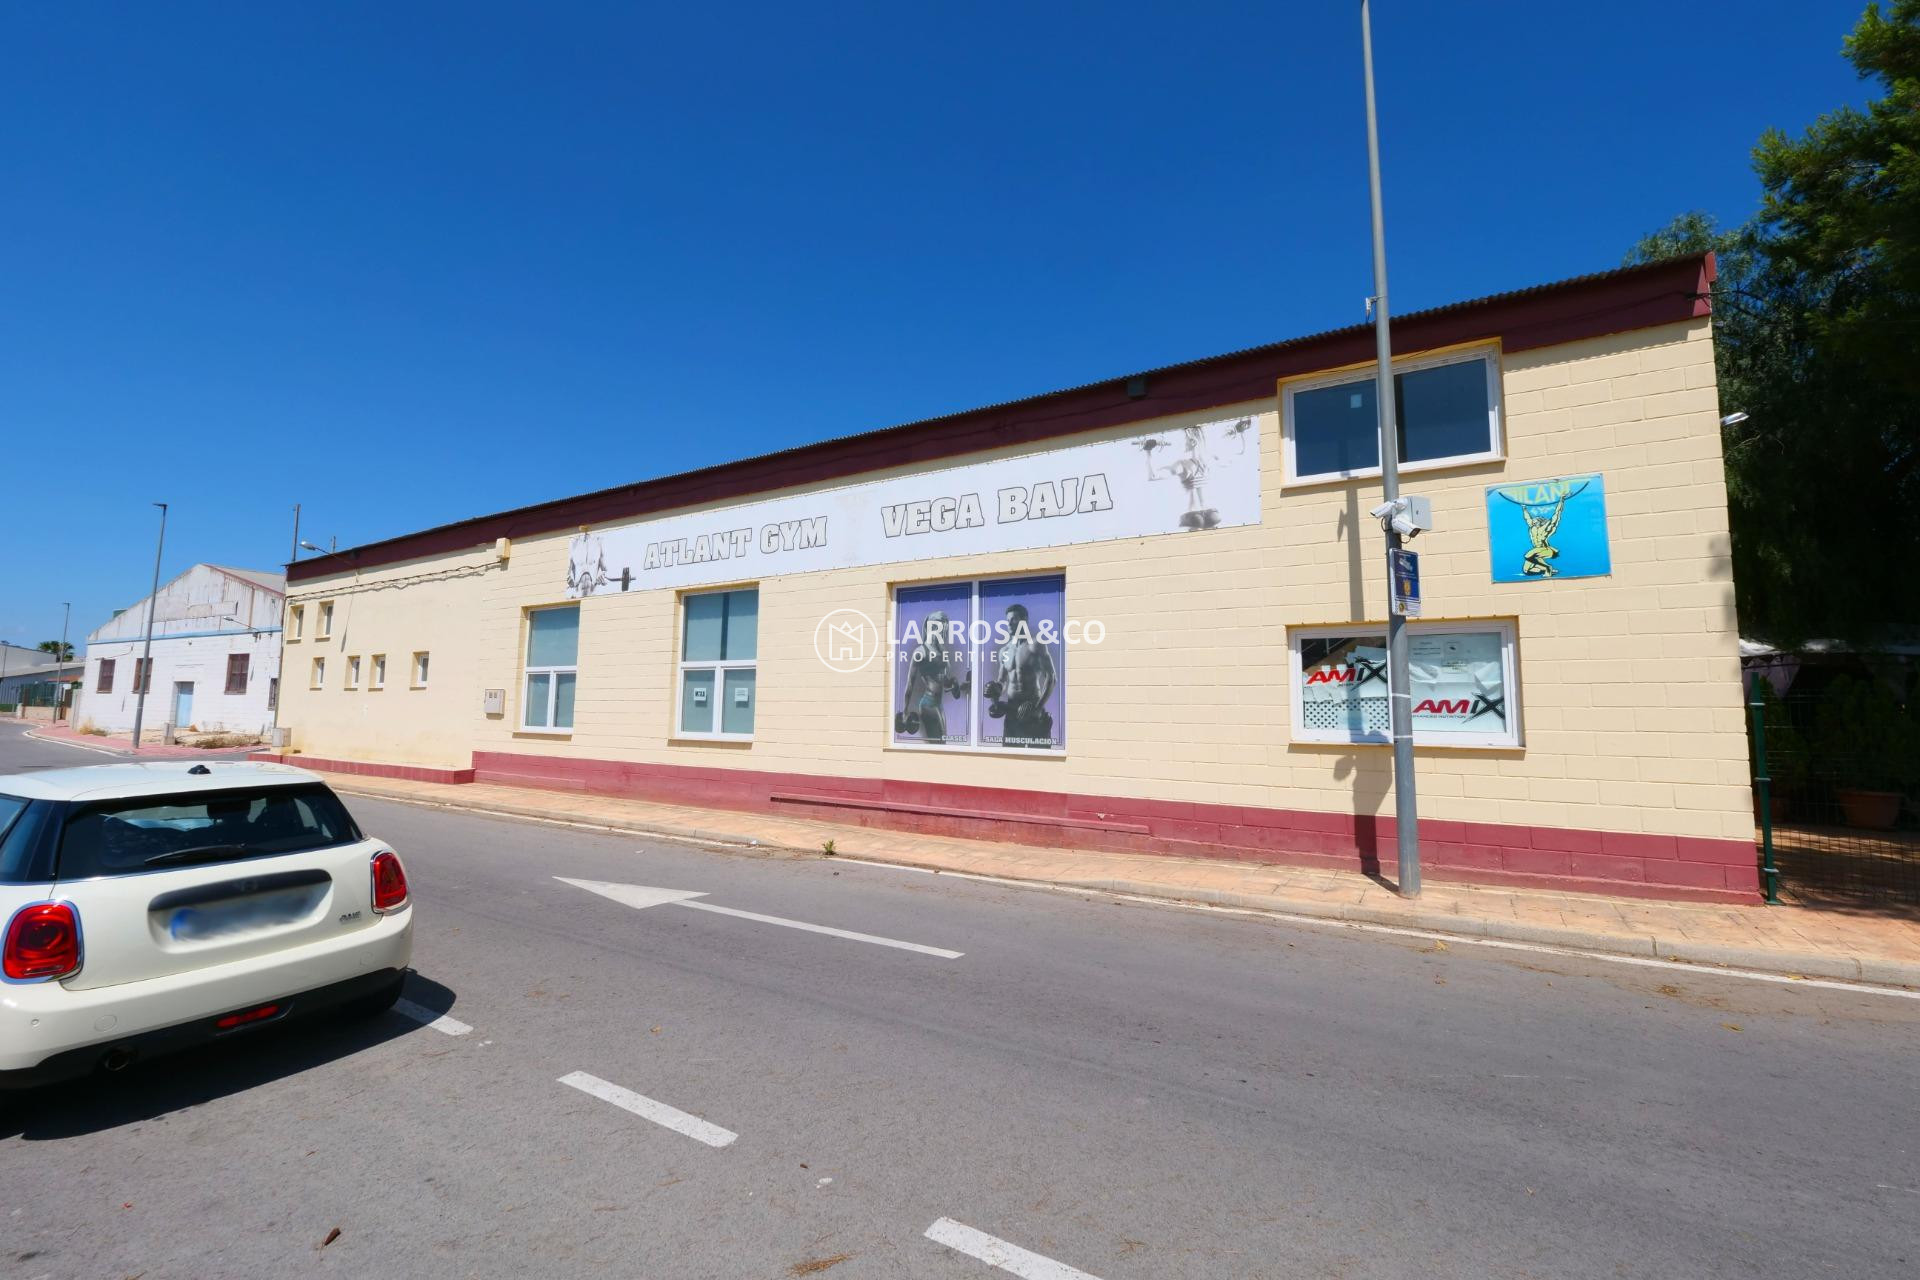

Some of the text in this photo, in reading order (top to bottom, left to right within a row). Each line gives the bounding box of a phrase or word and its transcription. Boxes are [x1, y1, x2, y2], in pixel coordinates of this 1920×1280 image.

[644, 473, 1113, 570] ATLANT GYM VEGA BAJA
[1412, 692, 1506, 724] AMIX
[985, 735, 1057, 745] SALA MUSCULACION
